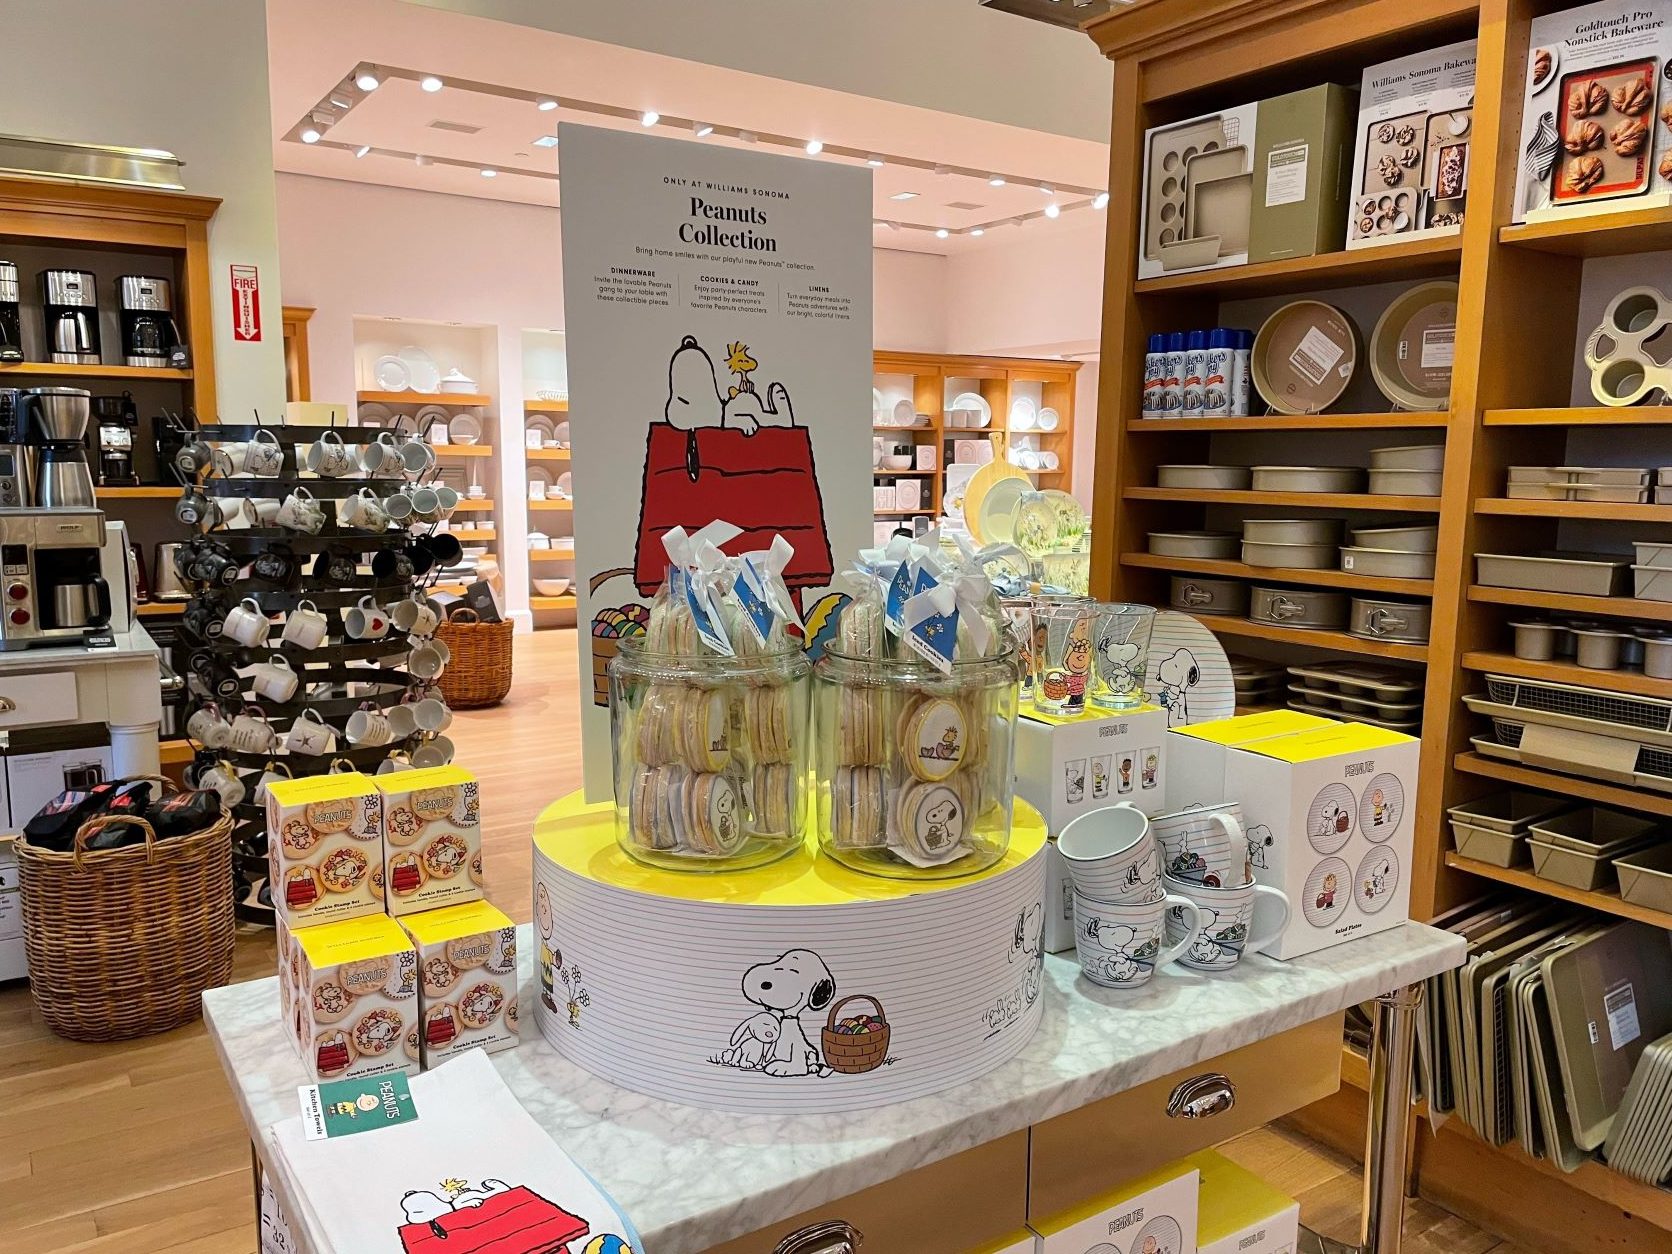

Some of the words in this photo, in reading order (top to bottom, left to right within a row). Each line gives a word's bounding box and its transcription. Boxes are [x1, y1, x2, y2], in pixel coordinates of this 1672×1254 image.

[1575, 14, 1629, 34] Goldtouch
[1633, 11, 1653, 21] Pro
[1564, 30, 1608, 47] Nonstick
[1611, 20, 1664, 38] Bakeware
[1372, 75, 1406, 88] Williams
[1408, 66, 1441, 79] Sonoma
[1444, 57, 1476, 71] Bakewa
[663, 176, 687, 186] ONLY
[691, 180, 701, 188] AT
[706, 182, 749, 194] WILLIAMS
[752, 188, 790, 200] SONOMA
[689, 196, 767, 225] Peanuts
[678, 222, 777, 252] Collection
[635, 246, 653, 257] Bring
[654, 248, 673, 257] home
[675, 251, 695, 259] smiles
[722, 256, 744, 265] playful
[611, 267, 656, 278] DINNERWARE
[234, 279, 255, 289] FIRE
[594, 275, 611, 283] Invite
[612, 277, 623, 285] the
[624, 278, 647, 287] lovable
[648, 280, 672, 289] Peanuts
[694, 284, 710, 293] Enjoy
[700, 275, 729, 284] COOKIES
[737, 279, 759, 287] CANDY
[597, 294, 615, 302] these
[616, 296, 648, 304] collectible
[598, 286, 616, 295] gang
[625, 288, 638, 296] your
[656, 290, 668, 298] with
[698, 294, 722, 302] inspired
[723, 296, 731, 304] by
[787, 292, 798, 300] Turn
[799, 295, 824, 303] everyday
[242, 289, 251, 336] EXTINGUISHER
[690, 301, 713, 310] favorite
[714, 303, 737, 311] Peanuts
[788, 301, 809, 309] Peanuts
[416, 796, 453, 811] PEANUTS
[314, 808, 353, 825] PEANUTS
[315, 904, 333, 912] Cookie
[1335, 926, 1348, 935] Salad
[1348, 923, 1362, 931] Plates
[453, 944, 490, 961] PEANUTS
[346, 967, 388, 986] PEANUTS
[452, 1042, 471, 1050] Cookie
[471, 1037, 487, 1045] Stamp
[346, 1068, 366, 1077] Cookie
[366, 1065, 384, 1074] Stamp
[309, 1089, 318, 1115] Kitchen
[379, 1080, 400, 1119] PEANUTS
[313, 1113, 323, 1135] Towels
[1108, 1207, 1144, 1236] PEANUTS
